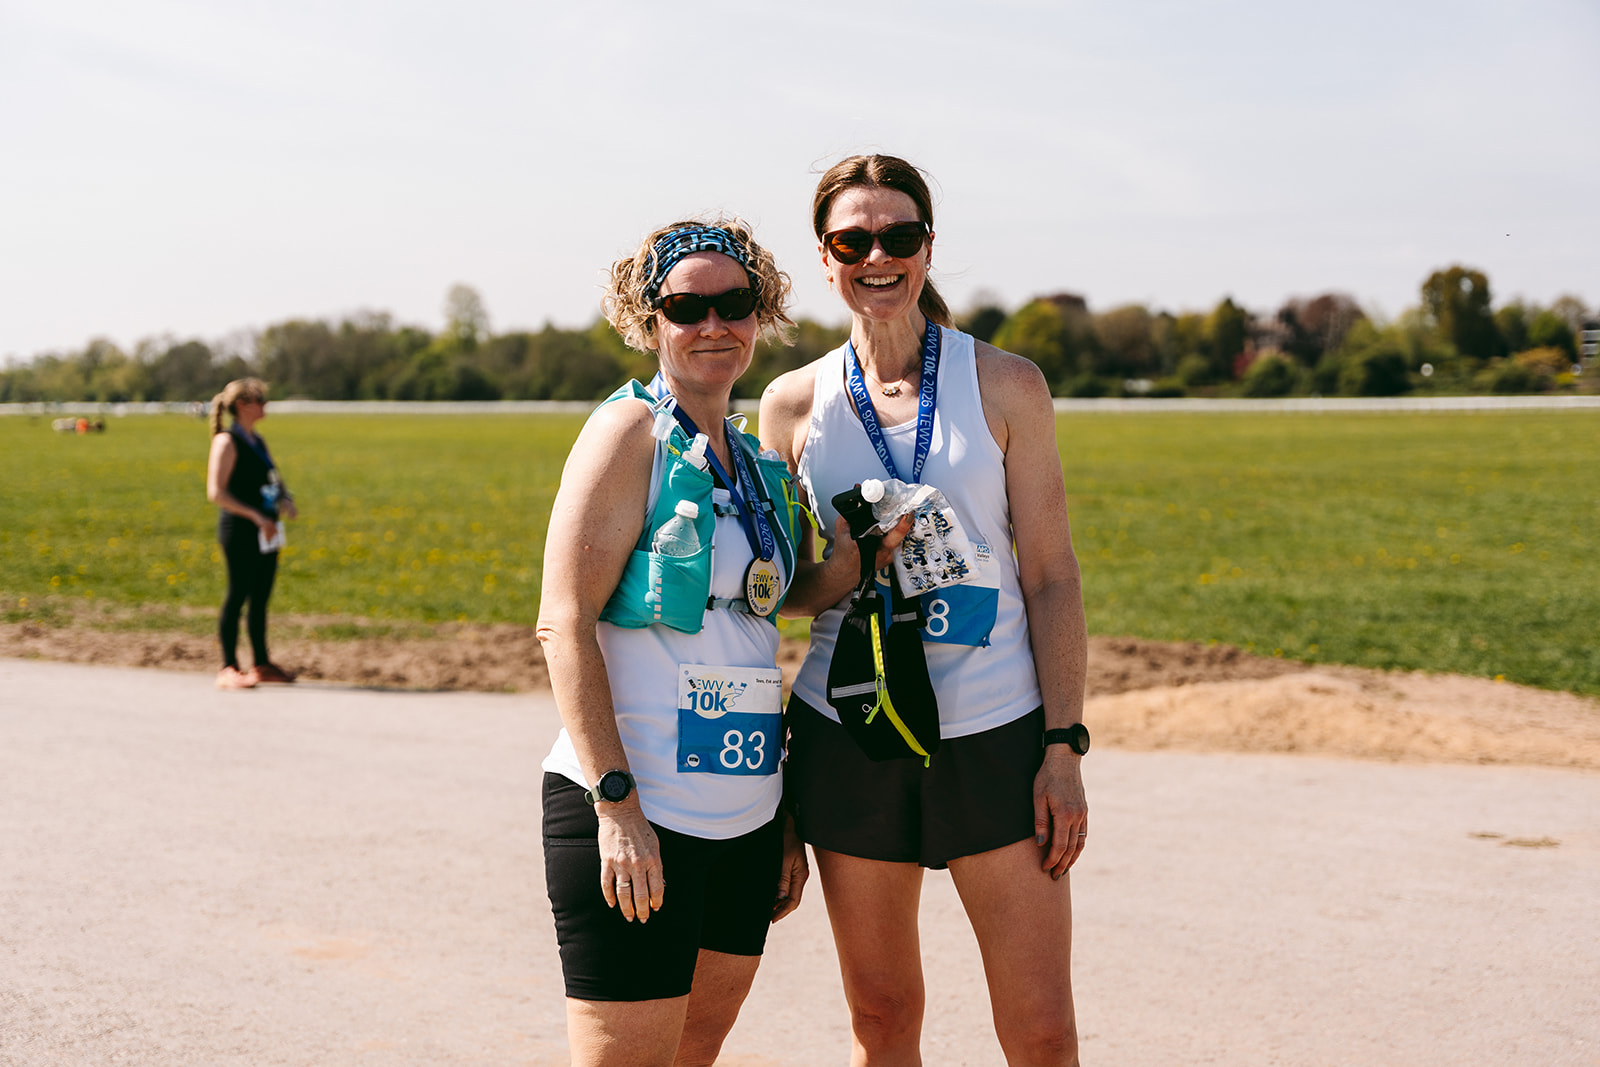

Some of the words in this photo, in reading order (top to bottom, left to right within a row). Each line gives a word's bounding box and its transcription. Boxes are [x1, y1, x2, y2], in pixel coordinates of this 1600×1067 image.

[850, 375, 869, 410] TEWV
[920, 379, 935, 408] 2026
[861, 409, 880, 440] 2026
[918, 412, 932, 451] TEWV
[760, 522, 773, 554] 2026
[752, 574, 769, 583] TEWV
[752, 583, 771, 599] 10k
[690, 679, 724, 690] EWV
[687, 691, 728, 712] 10k
[719, 729, 766, 770] 83
